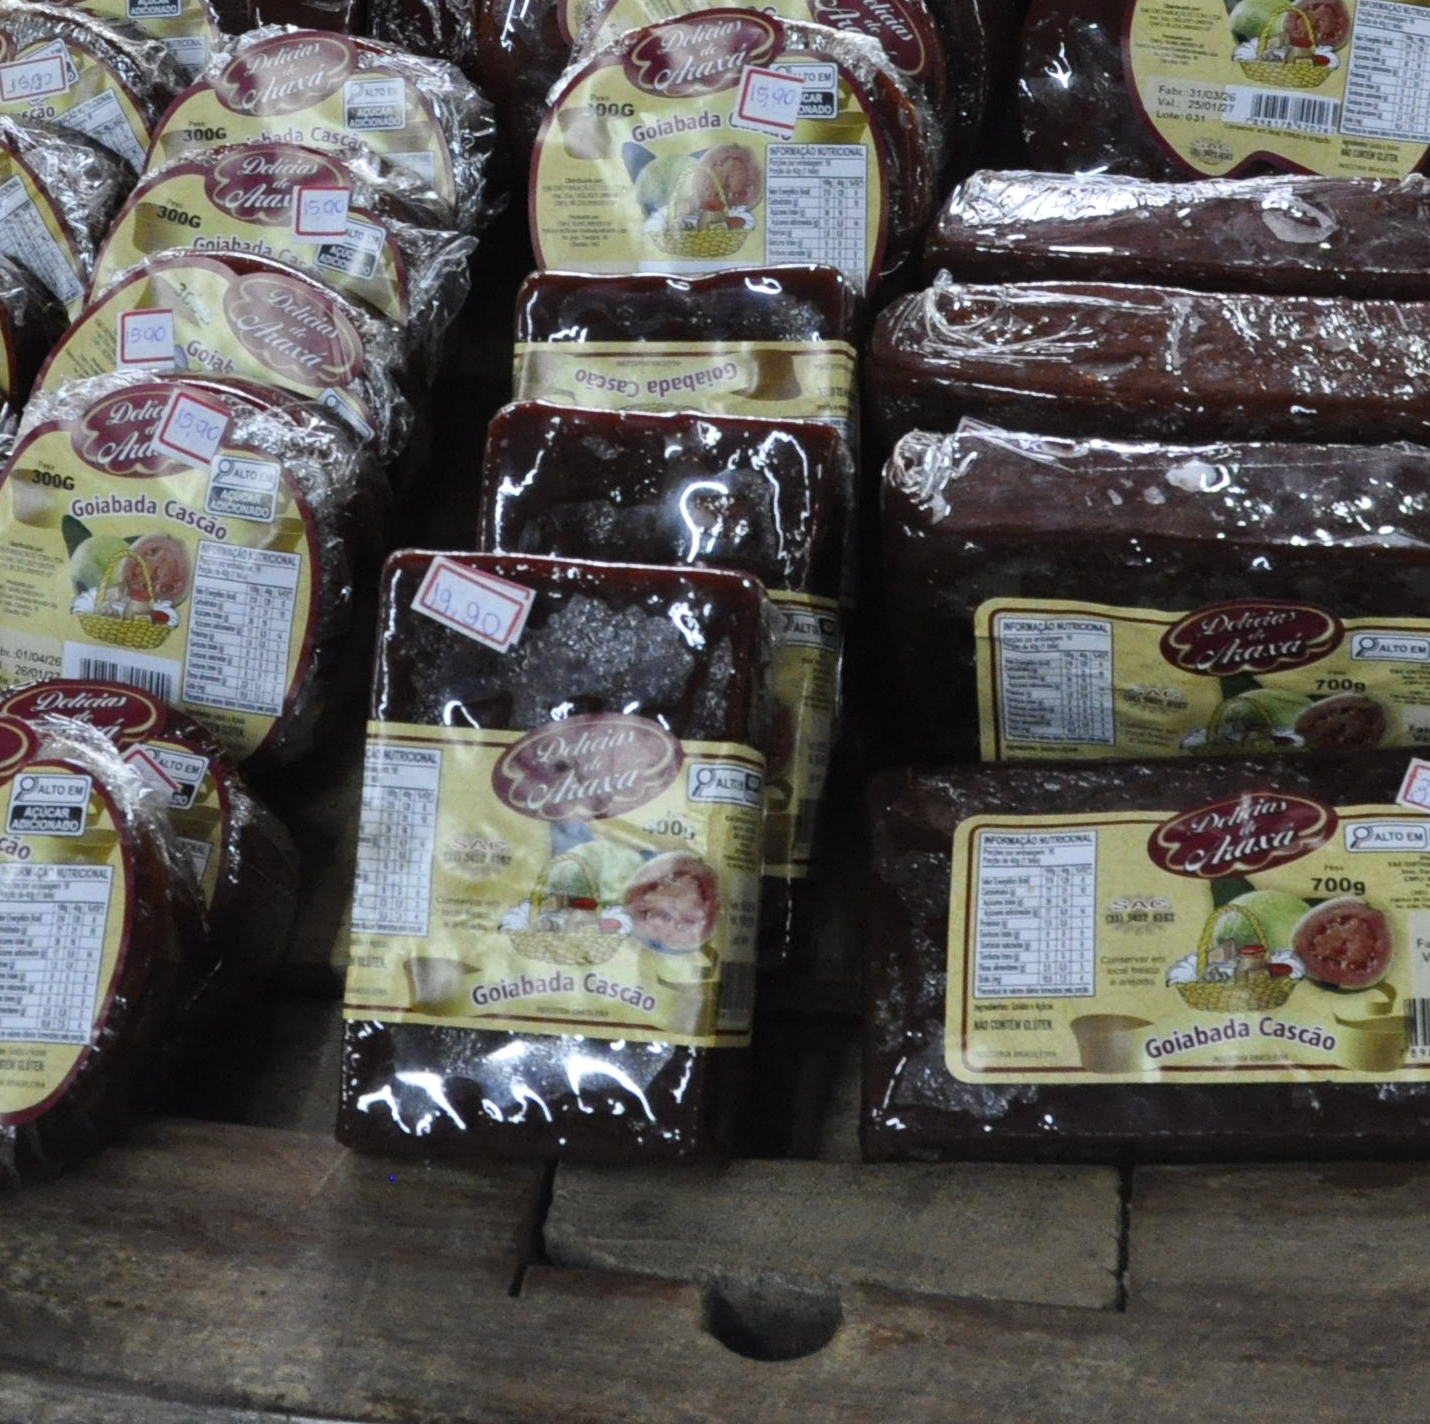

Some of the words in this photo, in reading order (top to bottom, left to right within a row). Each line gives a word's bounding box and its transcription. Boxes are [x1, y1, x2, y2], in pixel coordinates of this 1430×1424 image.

[1158, 85, 1189, 96] Fabr.:
[1189, 88, 1236, 102] 31/03/26
[1157, 97, 1181, 108] Val.:
[1188, 100, 1235, 113] 25/01/27
[1156, 110, 1184, 121] Lote:
[1186, 114, 1206, 123] 031
[183, 126, 227, 142] 300G
[631, 111, 722, 143] Goiabada
[156, 206, 202, 229] 300G
[575, 368, 640, 397] Cascão
[647, 363, 738, 395] Goiabada
[32, 470, 75, 491] 300G
[71, 494, 158, 519] Goiabada
[164, 501, 228, 541] Cascão
[1315, 678, 1366, 694] 700g
[384, 751, 437, 764] NUTRICIONAL
[37, 784, 63, 796] ALTO
[65, 785, 84, 797] EM
[24, 805, 70, 820] AÇÚCAR
[1191, 798, 1288, 836] Delícias
[11, 817, 80, 832] ADICIONADO
[984, 836, 1038, 846] INFORMAÇÃO
[1039, 834, 1092, 844] NUTRICIONAL
[1374, 832, 1404, 842] ALTO
[1406, 832, 1423, 842] EM
[1184, 823, 1295, 872] Araxá
[1310, 877, 1366, 896] 700g
[1110, 899, 1170, 911] SAC
[471, 971, 576, 1006] Goiabada
[582, 973, 657, 1011] Cascão
[1144, 1020, 1251, 1060] Goiabada
[1259, 1017, 1337, 1051] Cascão
